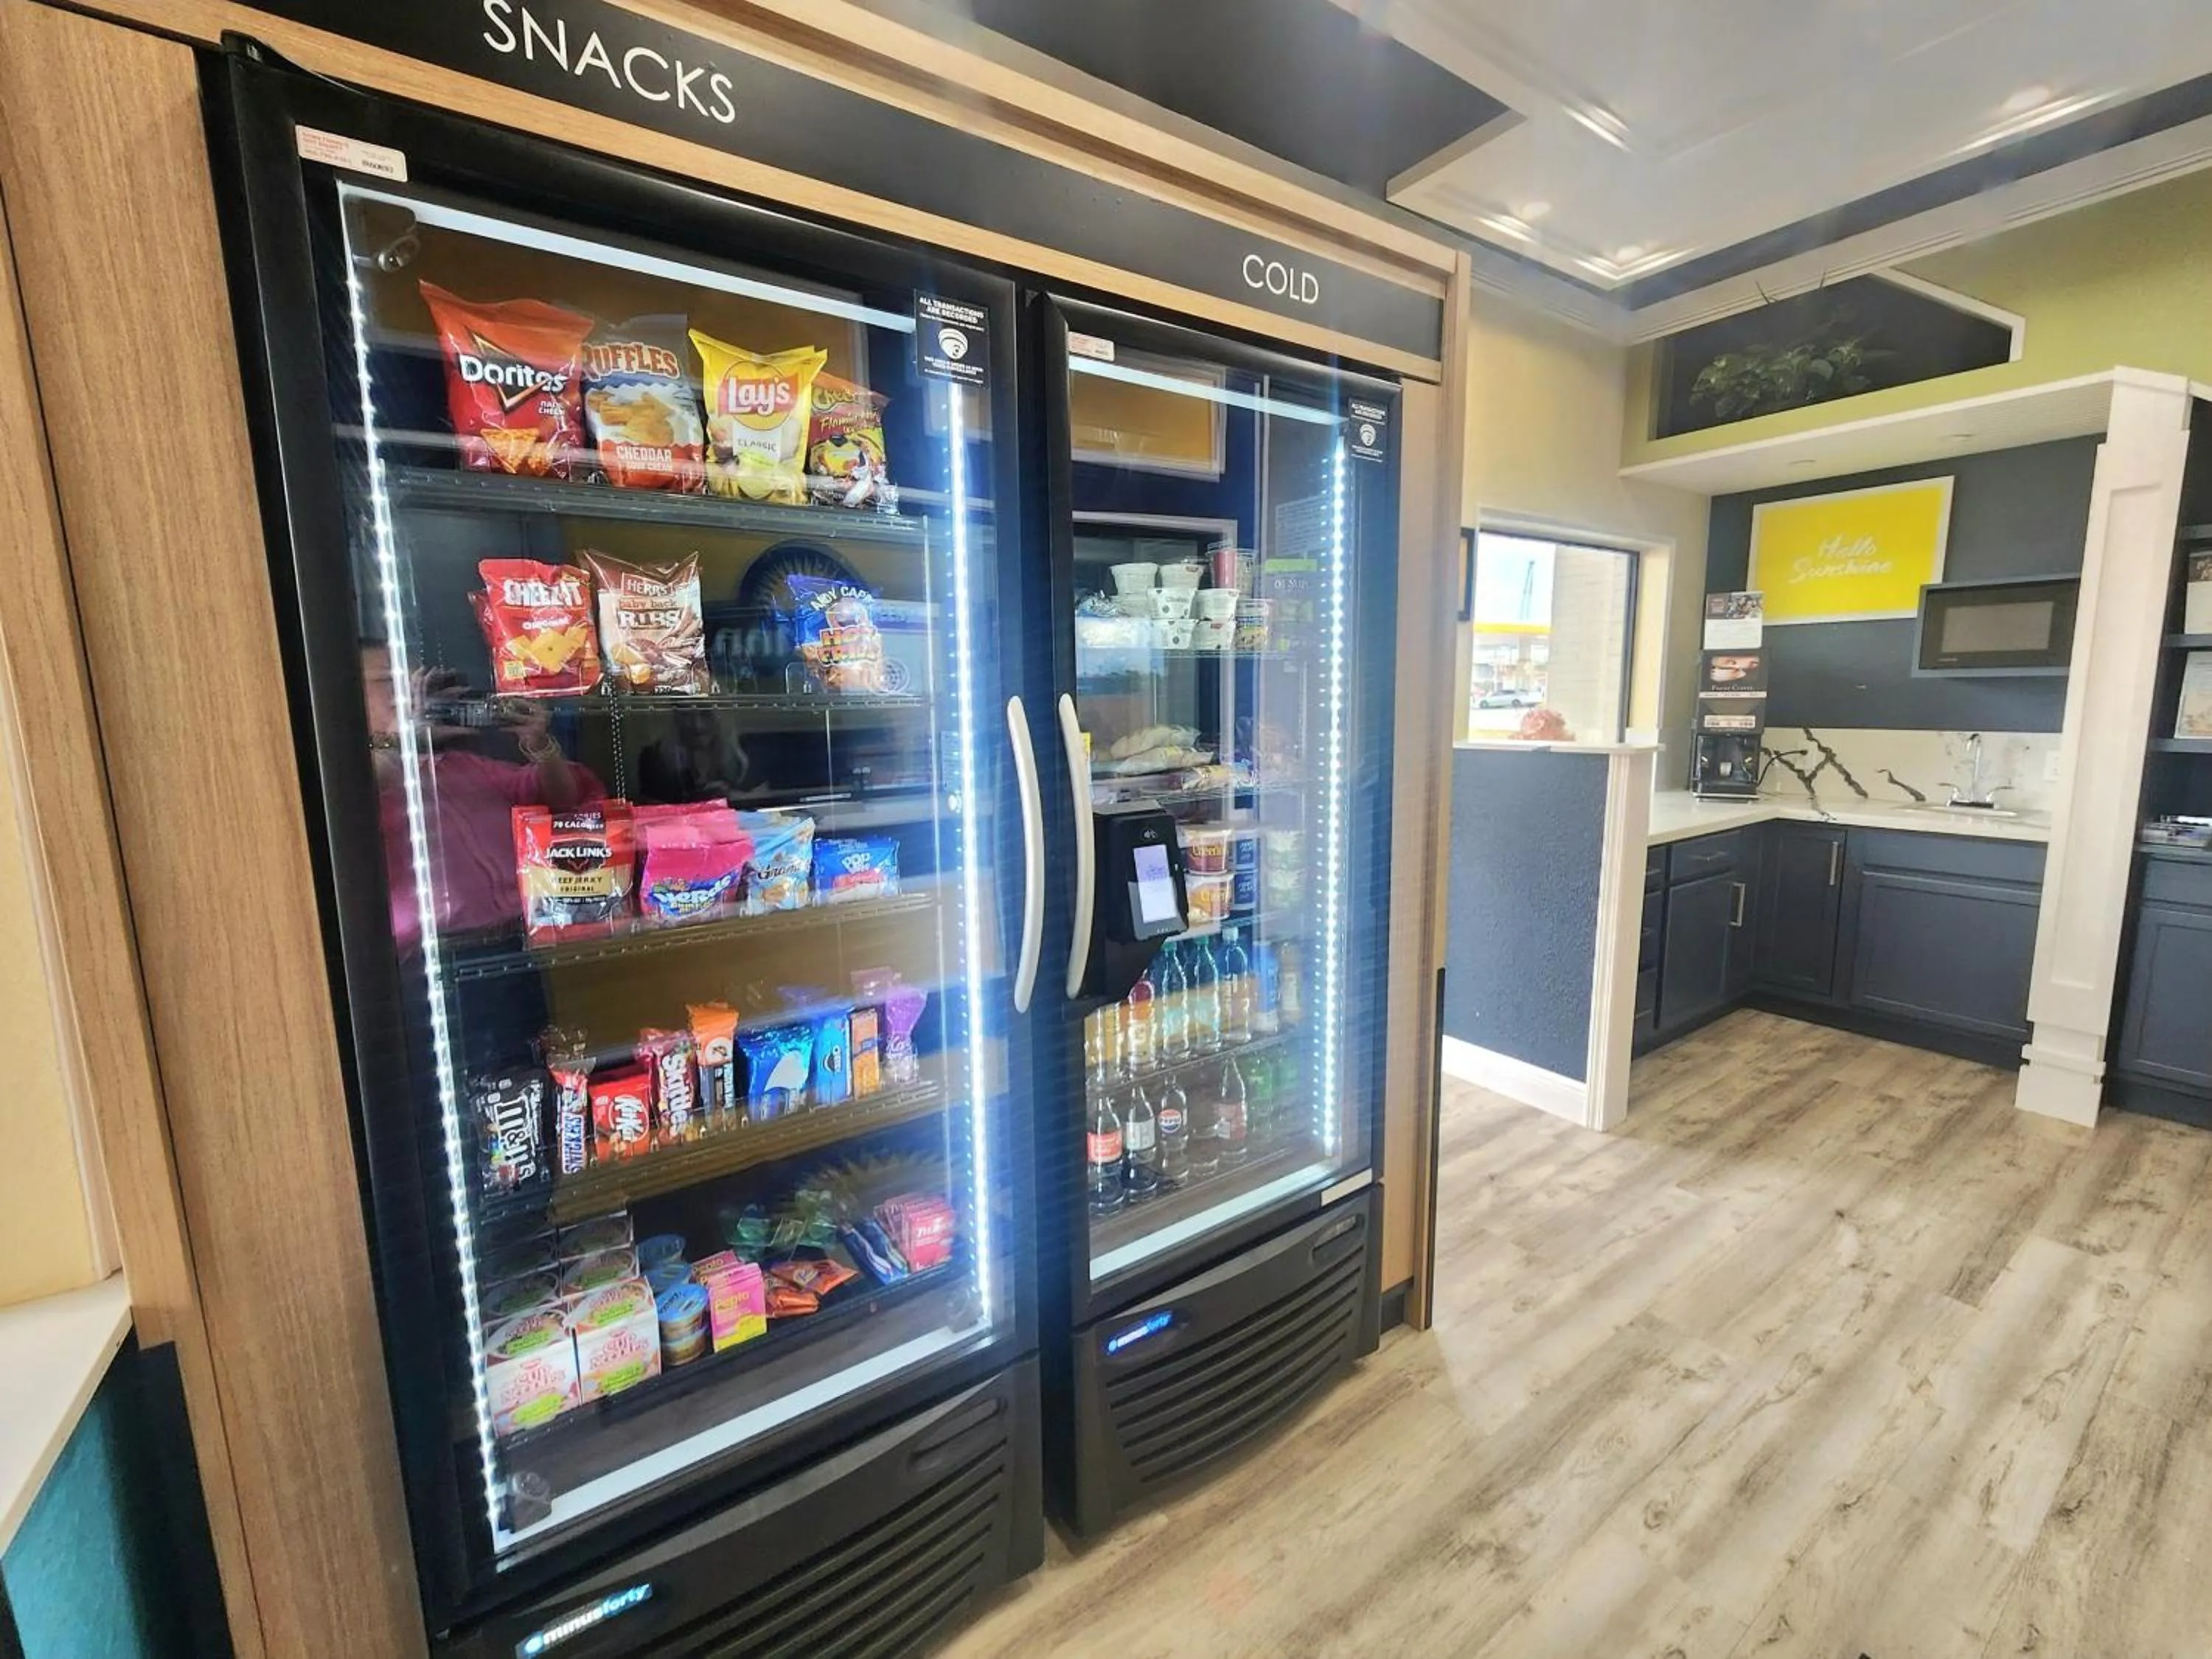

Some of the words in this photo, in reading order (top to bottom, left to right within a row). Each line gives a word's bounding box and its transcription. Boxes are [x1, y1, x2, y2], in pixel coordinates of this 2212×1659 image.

[483, 0, 736, 124] SNACKS
[1242, 254, 1319, 304] COLD
[459, 354, 568, 393] Doritos
[728, 377, 791, 416] Lay's
[616, 447, 672, 463] CHEDDAR
[544, 847, 575, 859] JACK
